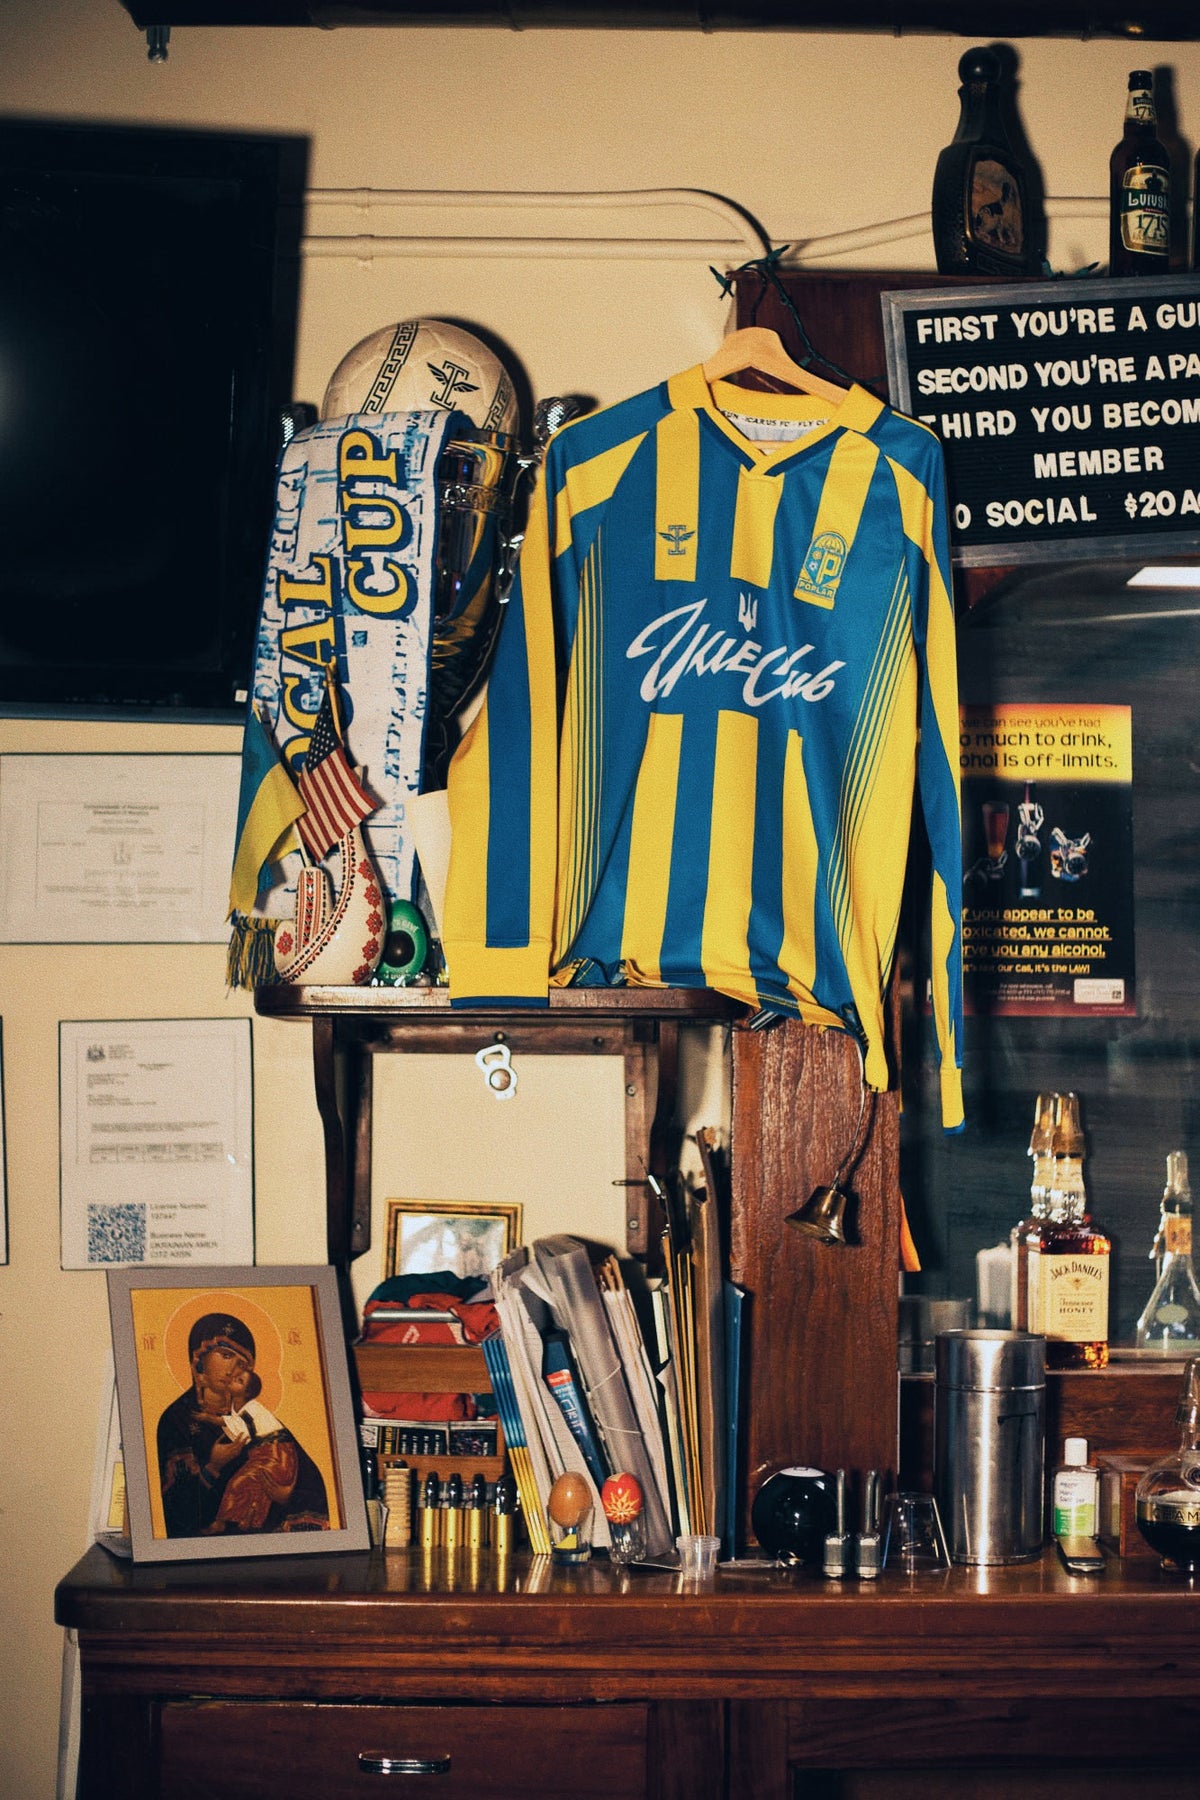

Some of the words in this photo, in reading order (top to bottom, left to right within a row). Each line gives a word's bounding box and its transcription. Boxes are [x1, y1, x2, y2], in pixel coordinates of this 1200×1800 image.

[917, 314, 998, 344] FIRST
[1011, 306, 1116, 339] YOU'RE
[1127, 305, 1148, 332] A
[1156, 301, 1200, 330] GU
[917, 363, 1028, 396] SECOND
[1034, 353, 1137, 388] YOU'RE
[1145, 355, 1166, 381] A
[1030, 404, 1093, 433] YOU
[1033, 446, 1164, 479] MEMBER
[985, 495, 1098, 529] SOCIAL
[1124, 490, 1177, 520] $20
[1180, 489, 1200, 516] A
[338, 428, 414, 618] CUP
[798, 579, 835, 599] POPLAR
[1008, 718, 1032, 728] see
[1034, 716, 1077, 732] you've
[1079, 716, 1101, 728] had
[959, 733, 971, 747] o
[976, 731, 1030, 747] much
[1036, 732, 1056, 746] to
[1060, 731, 1112, 748] drink,
[959, 752, 999, 768] ohol
[1003, 752, 1019, 768] is
[1024, 752, 1118, 769] off-limits.
[1003, 908, 1054, 922] appear
[1057, 907, 1074, 920] to
[1076, 907, 1095, 920] be
[963, 925, 1031, 941] oxicated,
[1033, 926, 1056, 938] we
[1058, 925, 1110, 939] cannot
[991, 944, 1018, 957] you
[1021, 945, 1049, 958] any
[1051, 963, 1068, 974] the
[1050, 1264, 1070, 1281] JACK
[1059, 1307, 1095, 1315] HONEY
